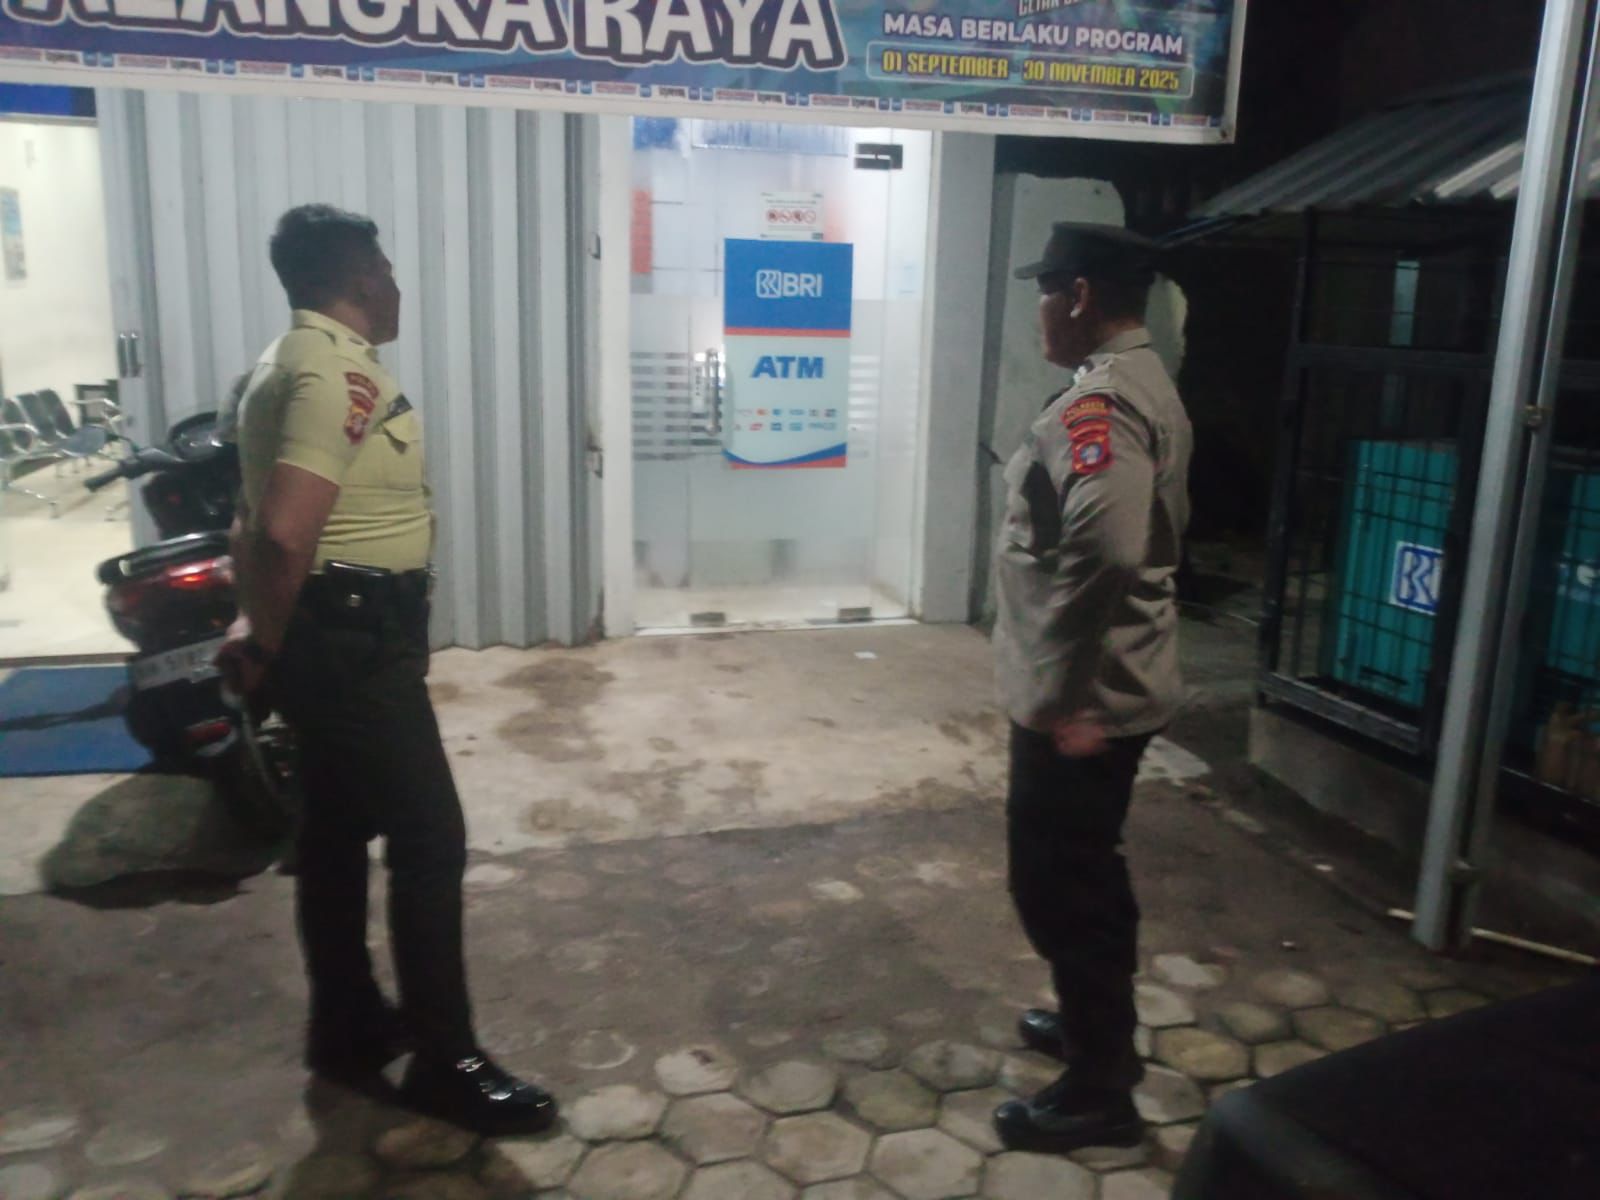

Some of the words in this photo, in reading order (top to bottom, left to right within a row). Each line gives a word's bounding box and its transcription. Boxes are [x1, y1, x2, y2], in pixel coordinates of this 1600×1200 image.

[584, 0, 834, 61] RAYA
[883, 12, 954, 38] MASA
[960, 18, 1069, 46] BERLAKU
[1075, 26, 1183, 55] PROGRAM
[883, 50, 902, 72] 01
[906, 52, 1009, 79] SEPTEMBER
[1023, 60, 1045, 81] 30
[1139, 68, 1180, 90] 2025
[782, 272, 823, 298] BRI
[750, 355, 824, 379] ATM
